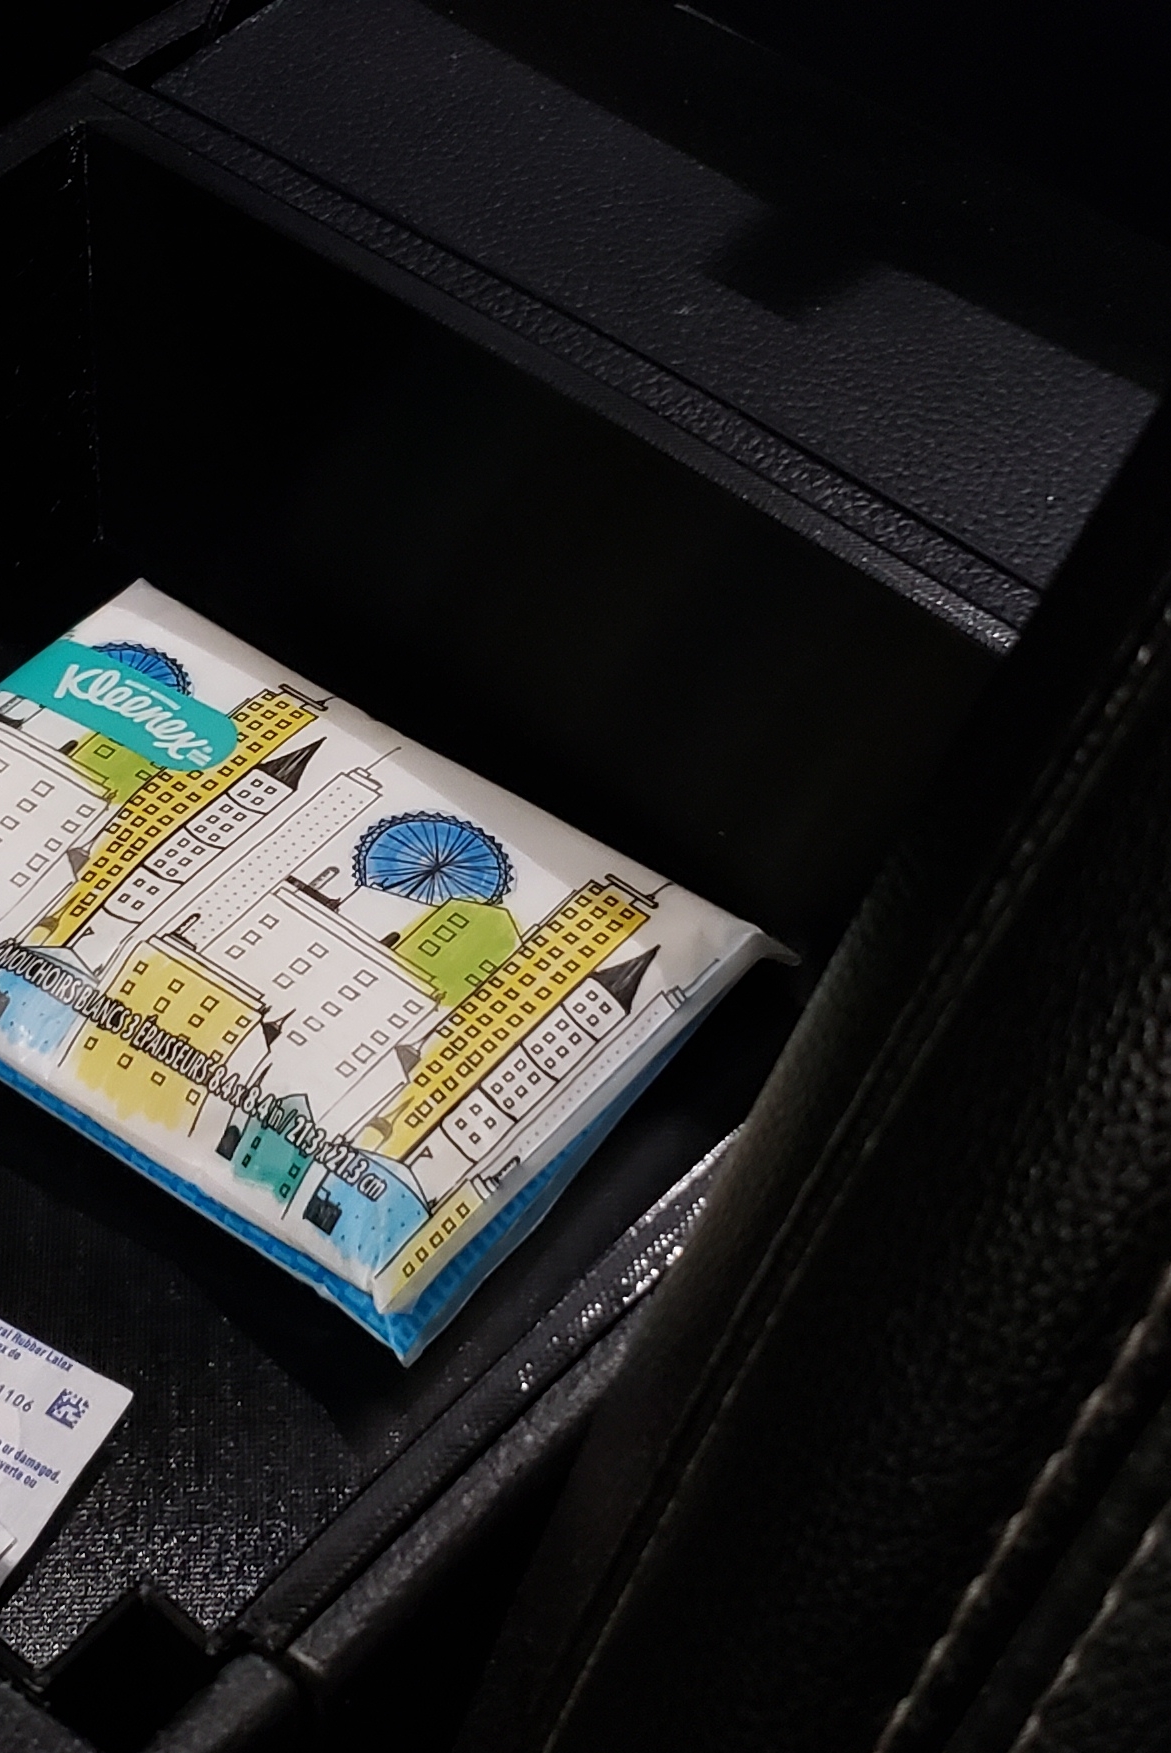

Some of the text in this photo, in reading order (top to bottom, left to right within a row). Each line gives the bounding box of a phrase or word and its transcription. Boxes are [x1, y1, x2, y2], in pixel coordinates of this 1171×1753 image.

[53, 663, 209, 761] Kleenex
[71, 983, 132, 1034] BLANCS
[120, 1013, 142, 1040] 3
[129, 1013, 214, 1085] ÉPAISSEURS
[208, 1064, 240, 1101] 8.4
[242, 1085, 275, 1122] 8.4
[266, 1100, 285, 1131] in
[285, 1114, 326, 1155] 21.3
[323, 1144, 369, 1186] 21.3
[357, 1173, 387, 1202] cm
[8, 1348, 21, 1360] de
[11, 1332, 47, 1357] Rubber
[45, 1350, 73, 1372] Latex
[2, 1444, 15, 1455] or
[14, 1449, 61, 1484] damaged.
[23, 1475, 37, 1488] ou
